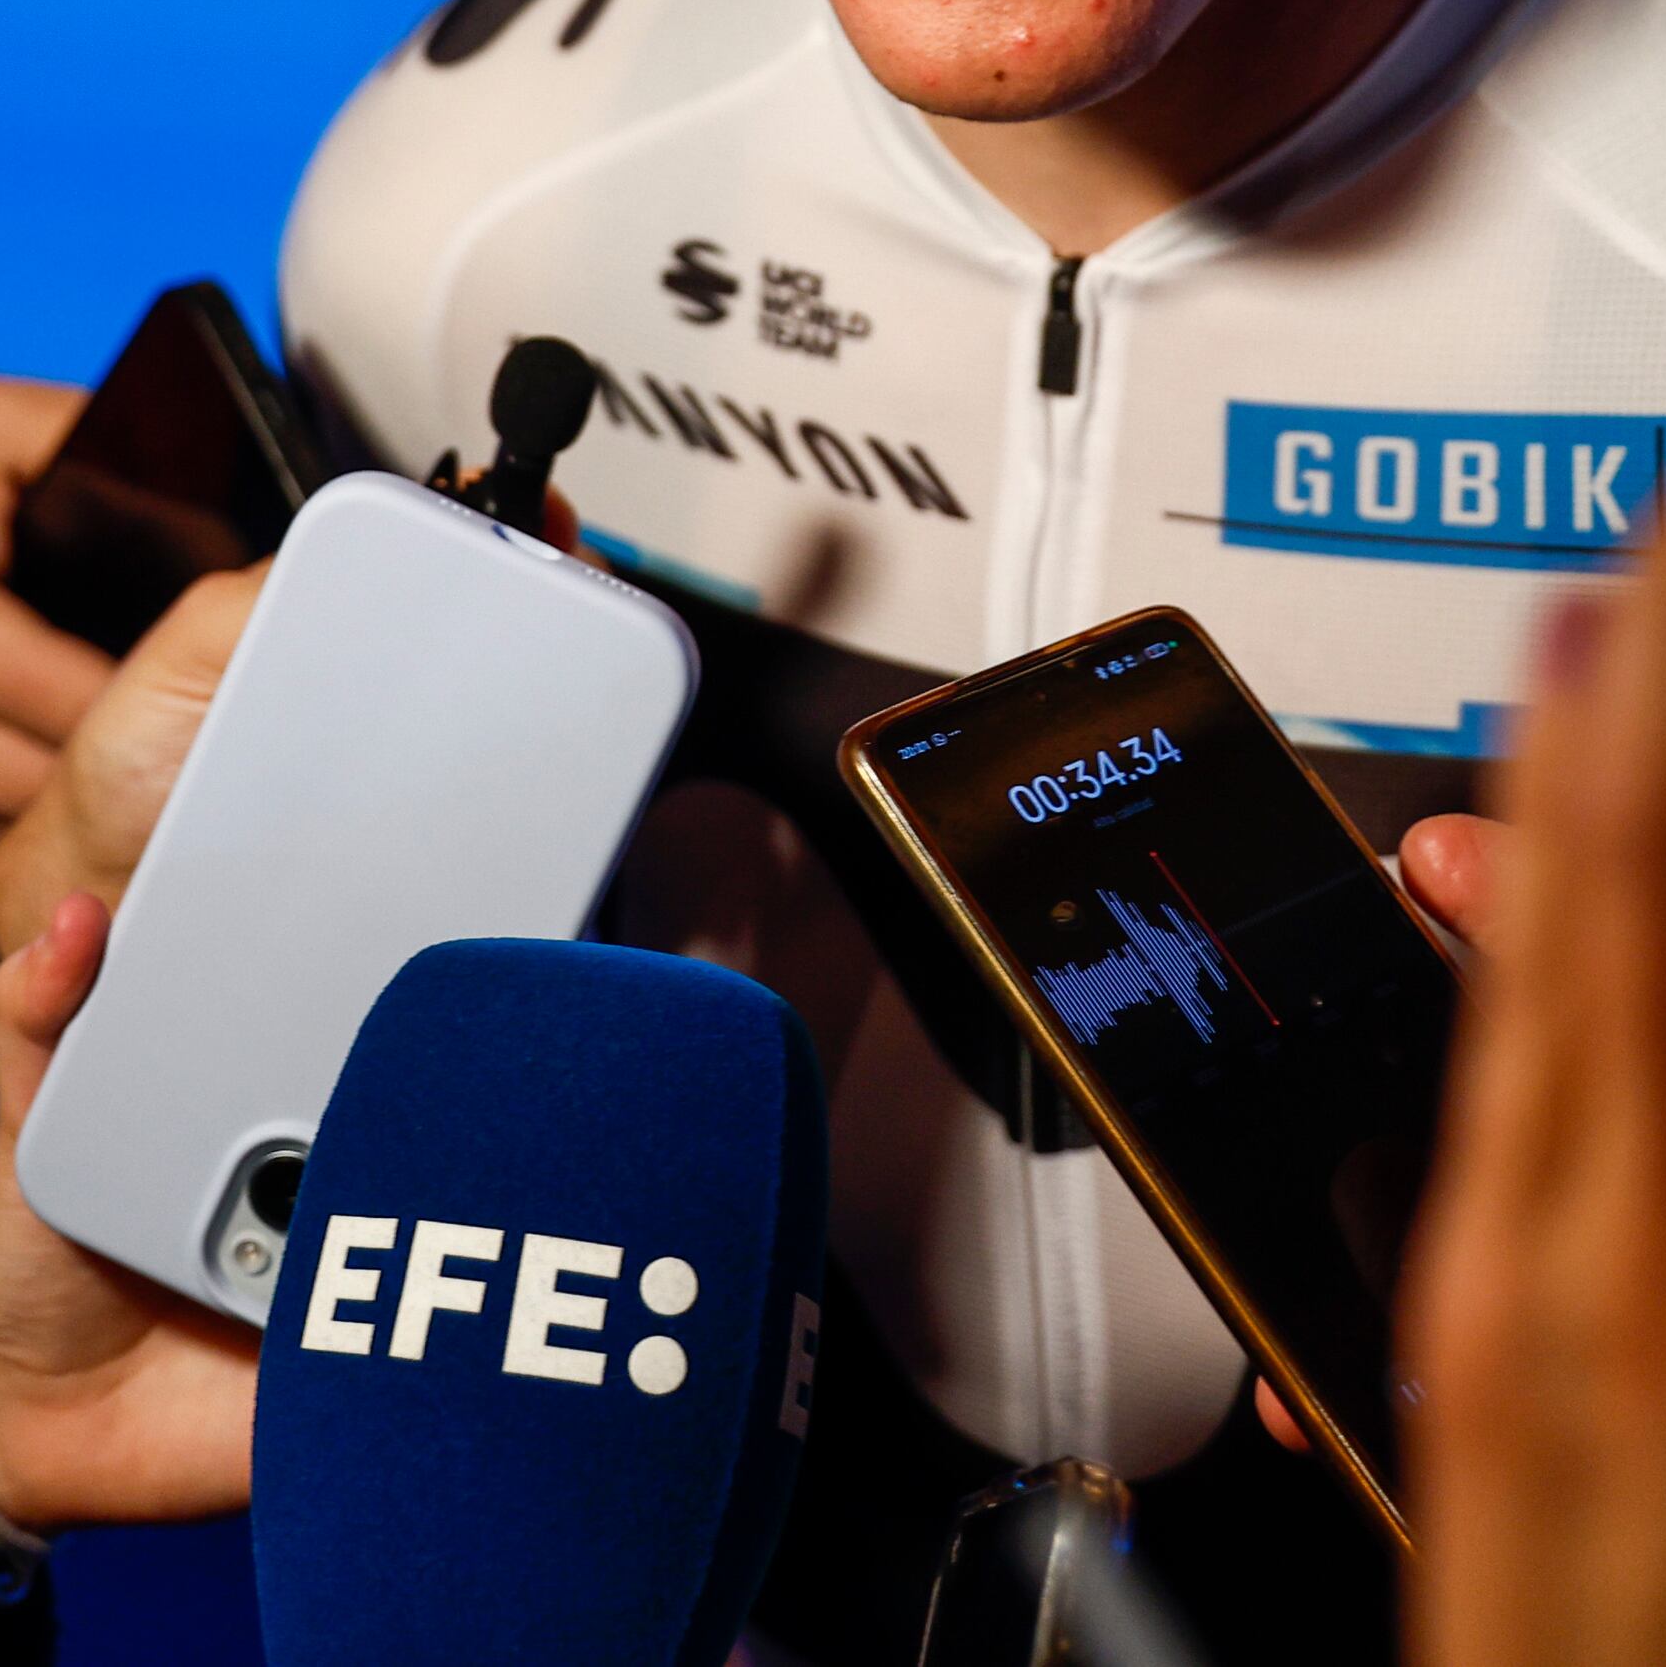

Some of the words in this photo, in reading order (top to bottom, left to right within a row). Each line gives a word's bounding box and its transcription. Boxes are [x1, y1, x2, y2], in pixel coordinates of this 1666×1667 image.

[761, 289, 872, 338] WORLD
[583, 356, 970, 522] ANYON
[1274, 430, 1629, 533] GOBIK
[1007, 727, 1183, 824] 00:34.34
[300, 1214, 699, 1397] EFE:
